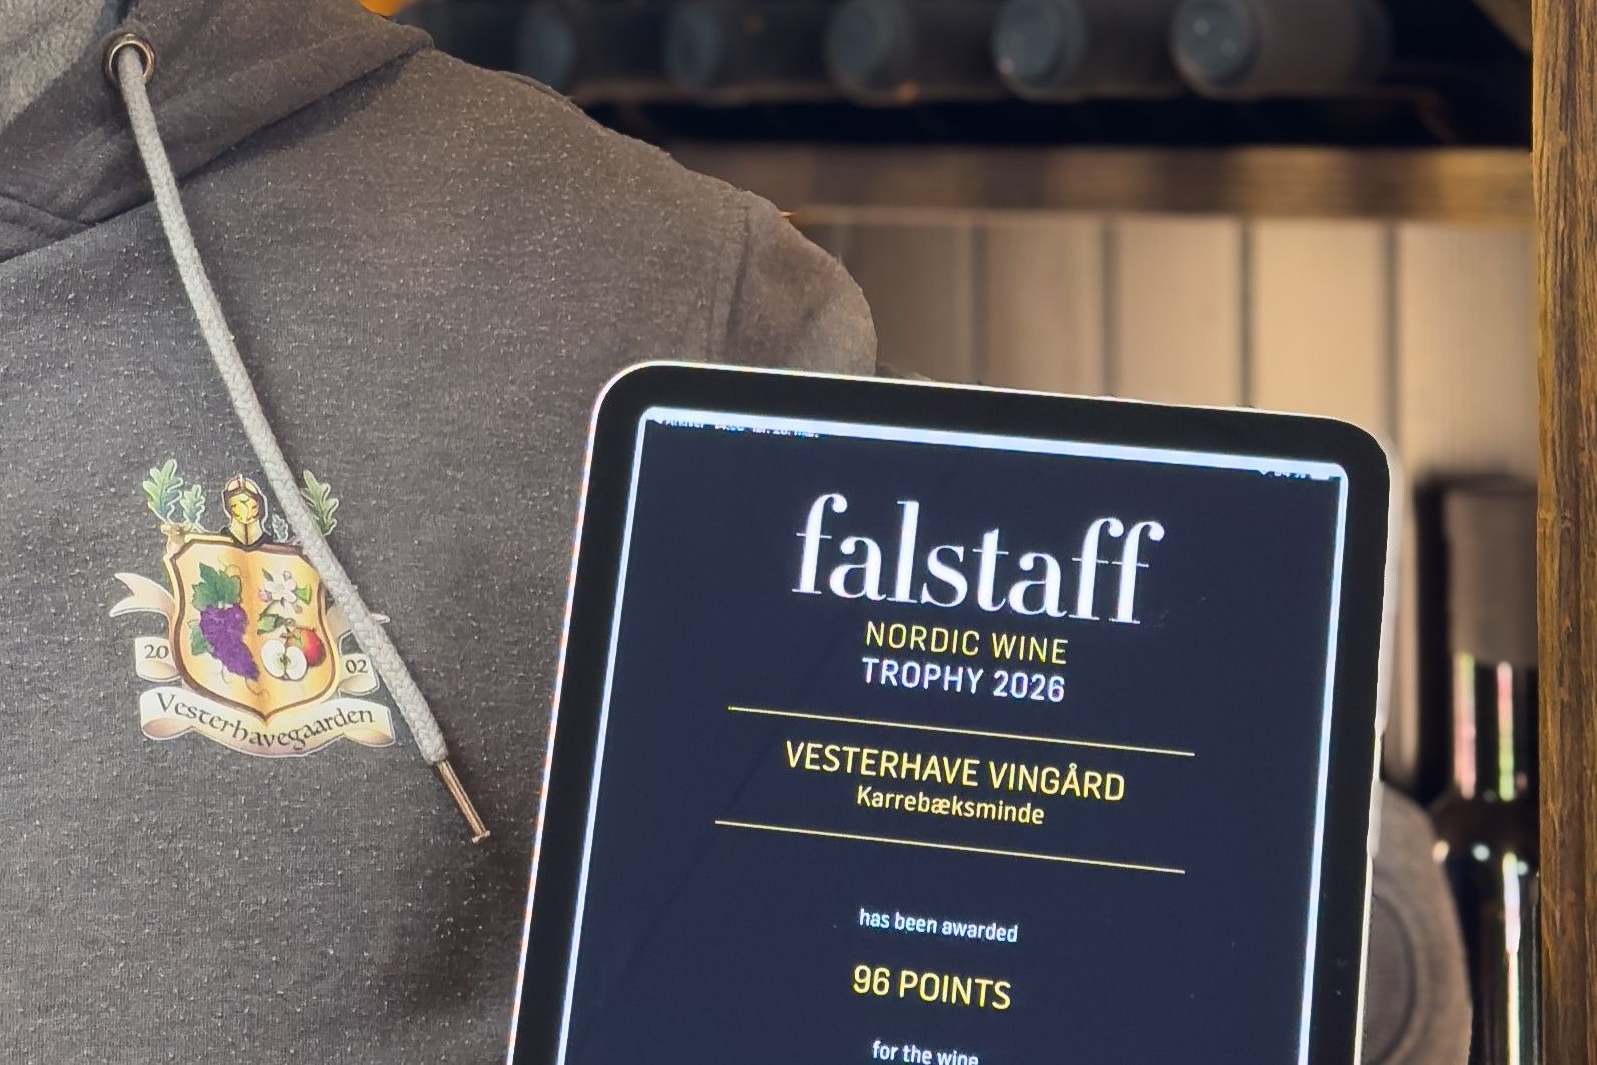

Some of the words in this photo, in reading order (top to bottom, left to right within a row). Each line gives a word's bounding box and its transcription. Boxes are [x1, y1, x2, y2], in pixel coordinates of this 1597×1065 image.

[791, 492, 1165, 625] falstaff
[144, 643, 169, 660] 20
[865, 620, 980, 657] NORDIC
[991, 632, 1069, 665] WINE
[345, 659, 367, 674] 02
[861, 657, 985, 695] TROPHY
[992, 670, 1066, 703] 2026
[156, 692, 374, 750] Vesterhavegaarden
[785, 740, 980, 787] VESTERHAVE
[988, 761, 1125, 801] VINGÅRD
[856, 785, 1045, 825] Karrebæksminde
[859, 908, 890, 929] has
[894, 911, 937, 934] been
[941, 922, 1019, 943] awarded
[853, 965, 891, 996] 96
[899, 969, 1012, 1010] POINTS
[872, 1039, 898, 1061] for
[903, 1044, 933, 1065] the
[937, 1049, 979, 1065] wine
